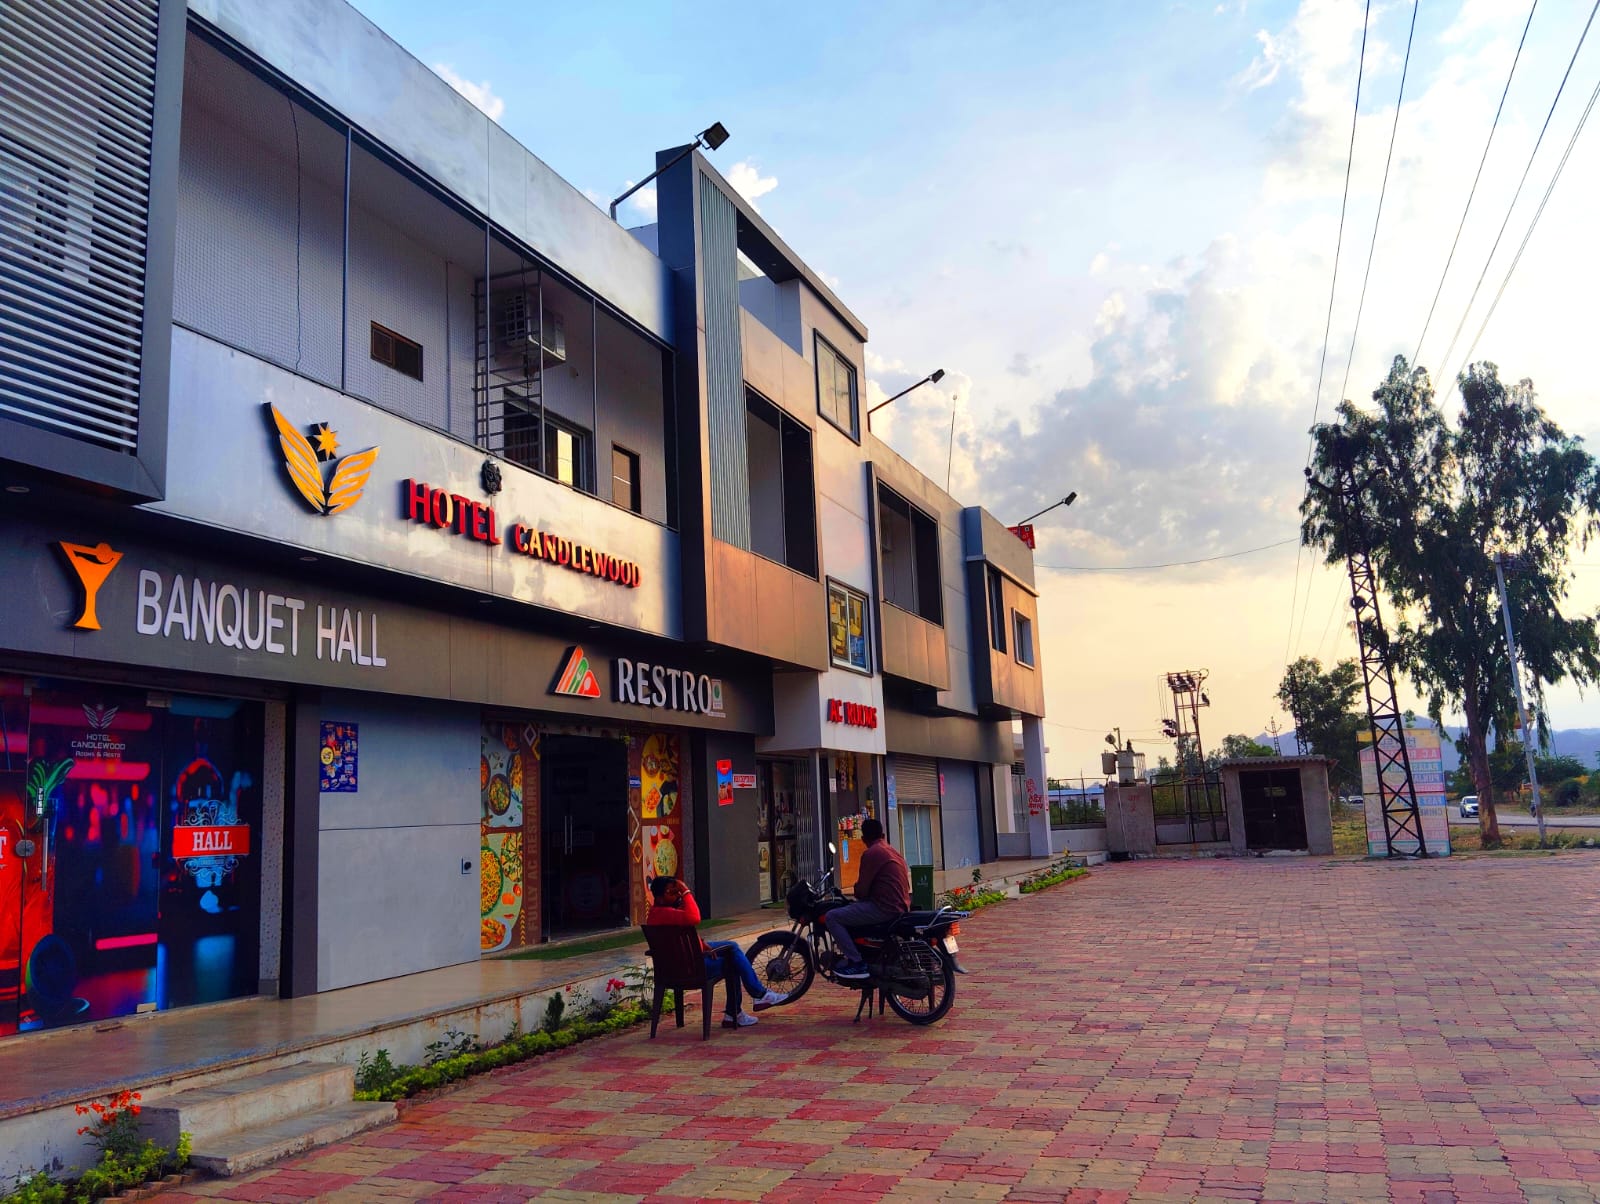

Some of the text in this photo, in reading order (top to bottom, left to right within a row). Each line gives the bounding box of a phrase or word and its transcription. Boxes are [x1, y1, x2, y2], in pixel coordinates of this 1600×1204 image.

[403, 478, 641, 588] HOTEL CANDLEWOOD
[136, 570, 388, 668] BANQUET HALL
[616, 657, 712, 714] RESTRO
[828, 698, 877, 729] AC ROOMS
[71, 741, 126, 750] CANDLEWOOD
[86, 733, 112, 742] HOTEL
[192, 831, 233, 852] HALL
[527, 859, 538, 880] AC
[527, 885, 538, 931] FULLY
